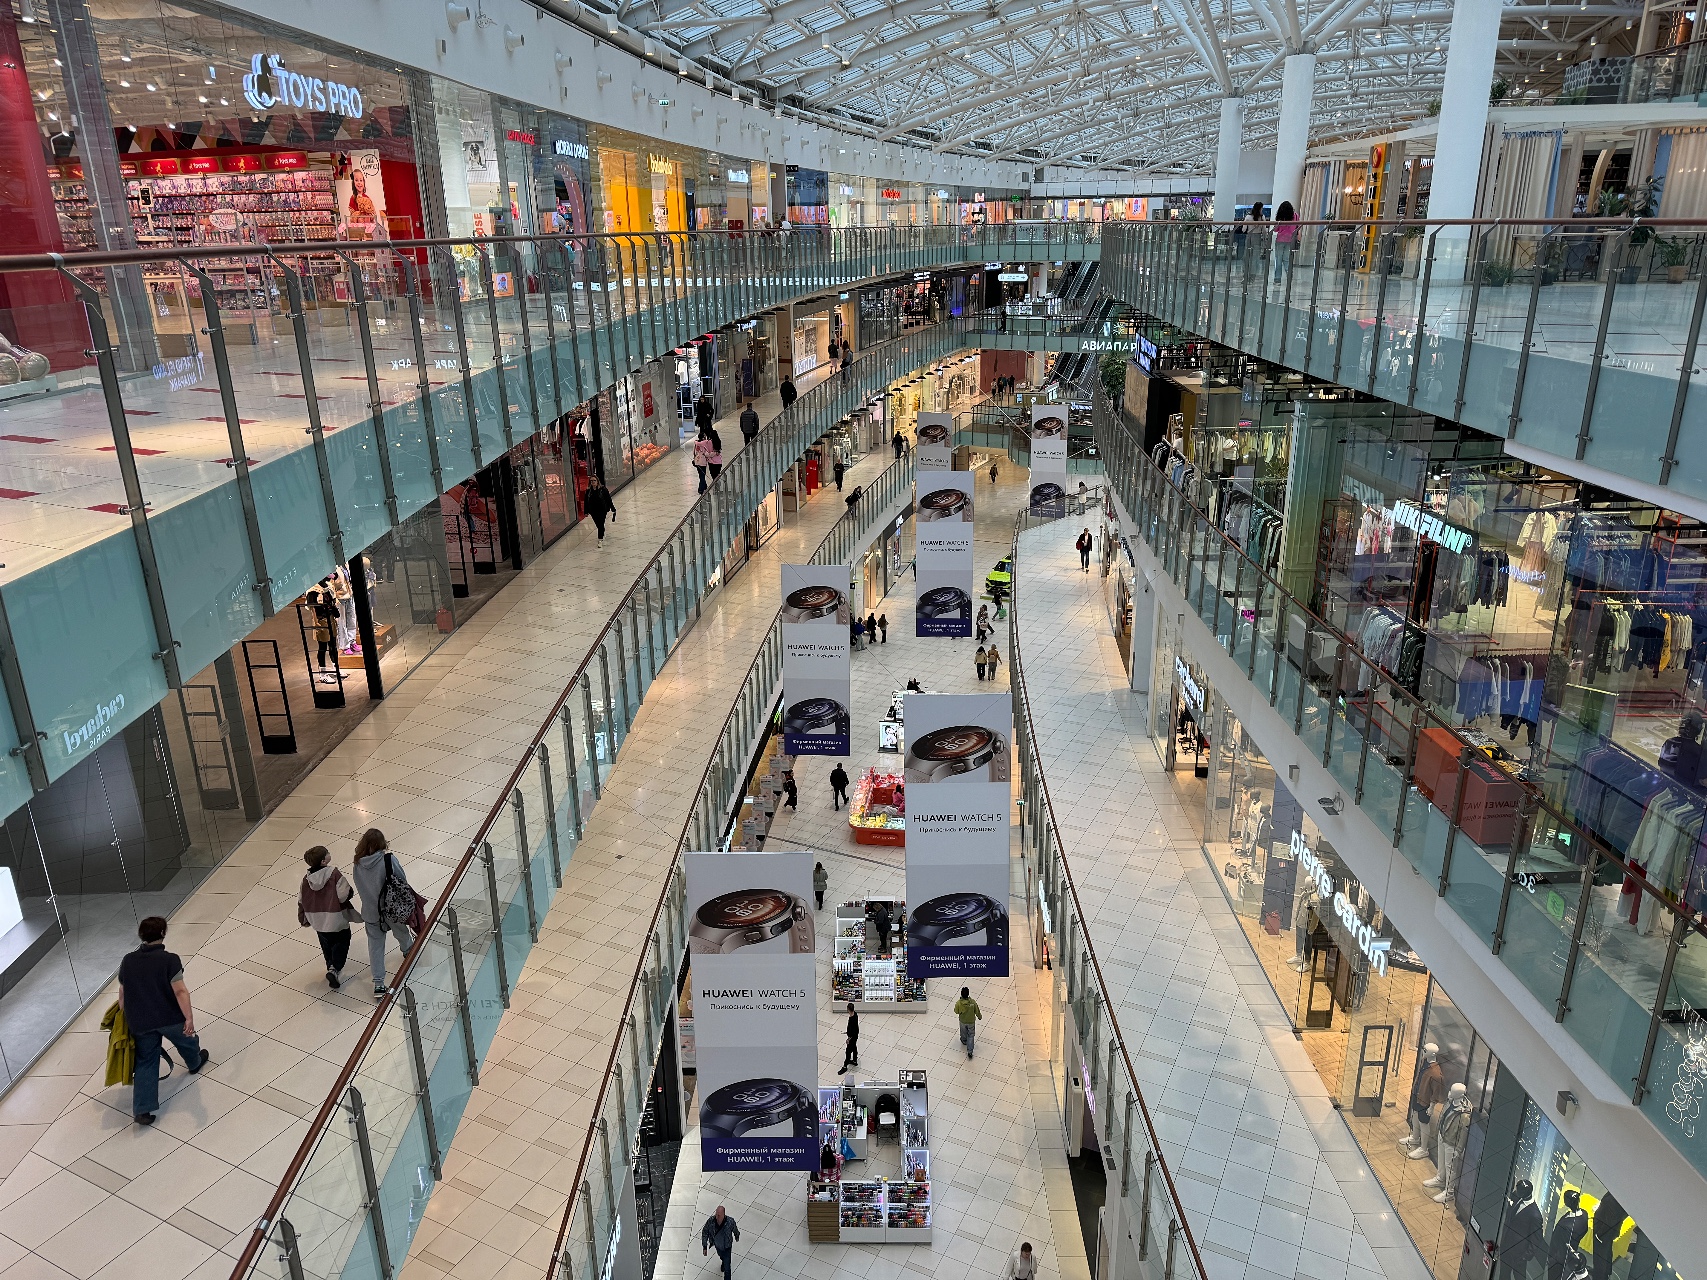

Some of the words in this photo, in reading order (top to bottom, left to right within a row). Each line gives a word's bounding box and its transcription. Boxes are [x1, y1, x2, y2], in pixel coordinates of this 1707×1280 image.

[275, 69, 327, 112] TOYS
[327, 81, 363, 119] PRO
[1082, 340, 1137, 352] АВИАПАР
[913, 814, 957, 823] HUAWEI
[960, 813, 994, 822] WATCH
[996, 813, 1002, 822] 5
[1290, 829, 1334, 899] pierre
[1334, 891, 1388, 978] cardin
[702, 989, 754, 998] HUAWEI
[757, 989, 797, 998] WATCH
[800, 989, 806, 998] 5
[762, 1003, 800, 1011] будущему
[716, 1147, 768, 1155] Фирменный
